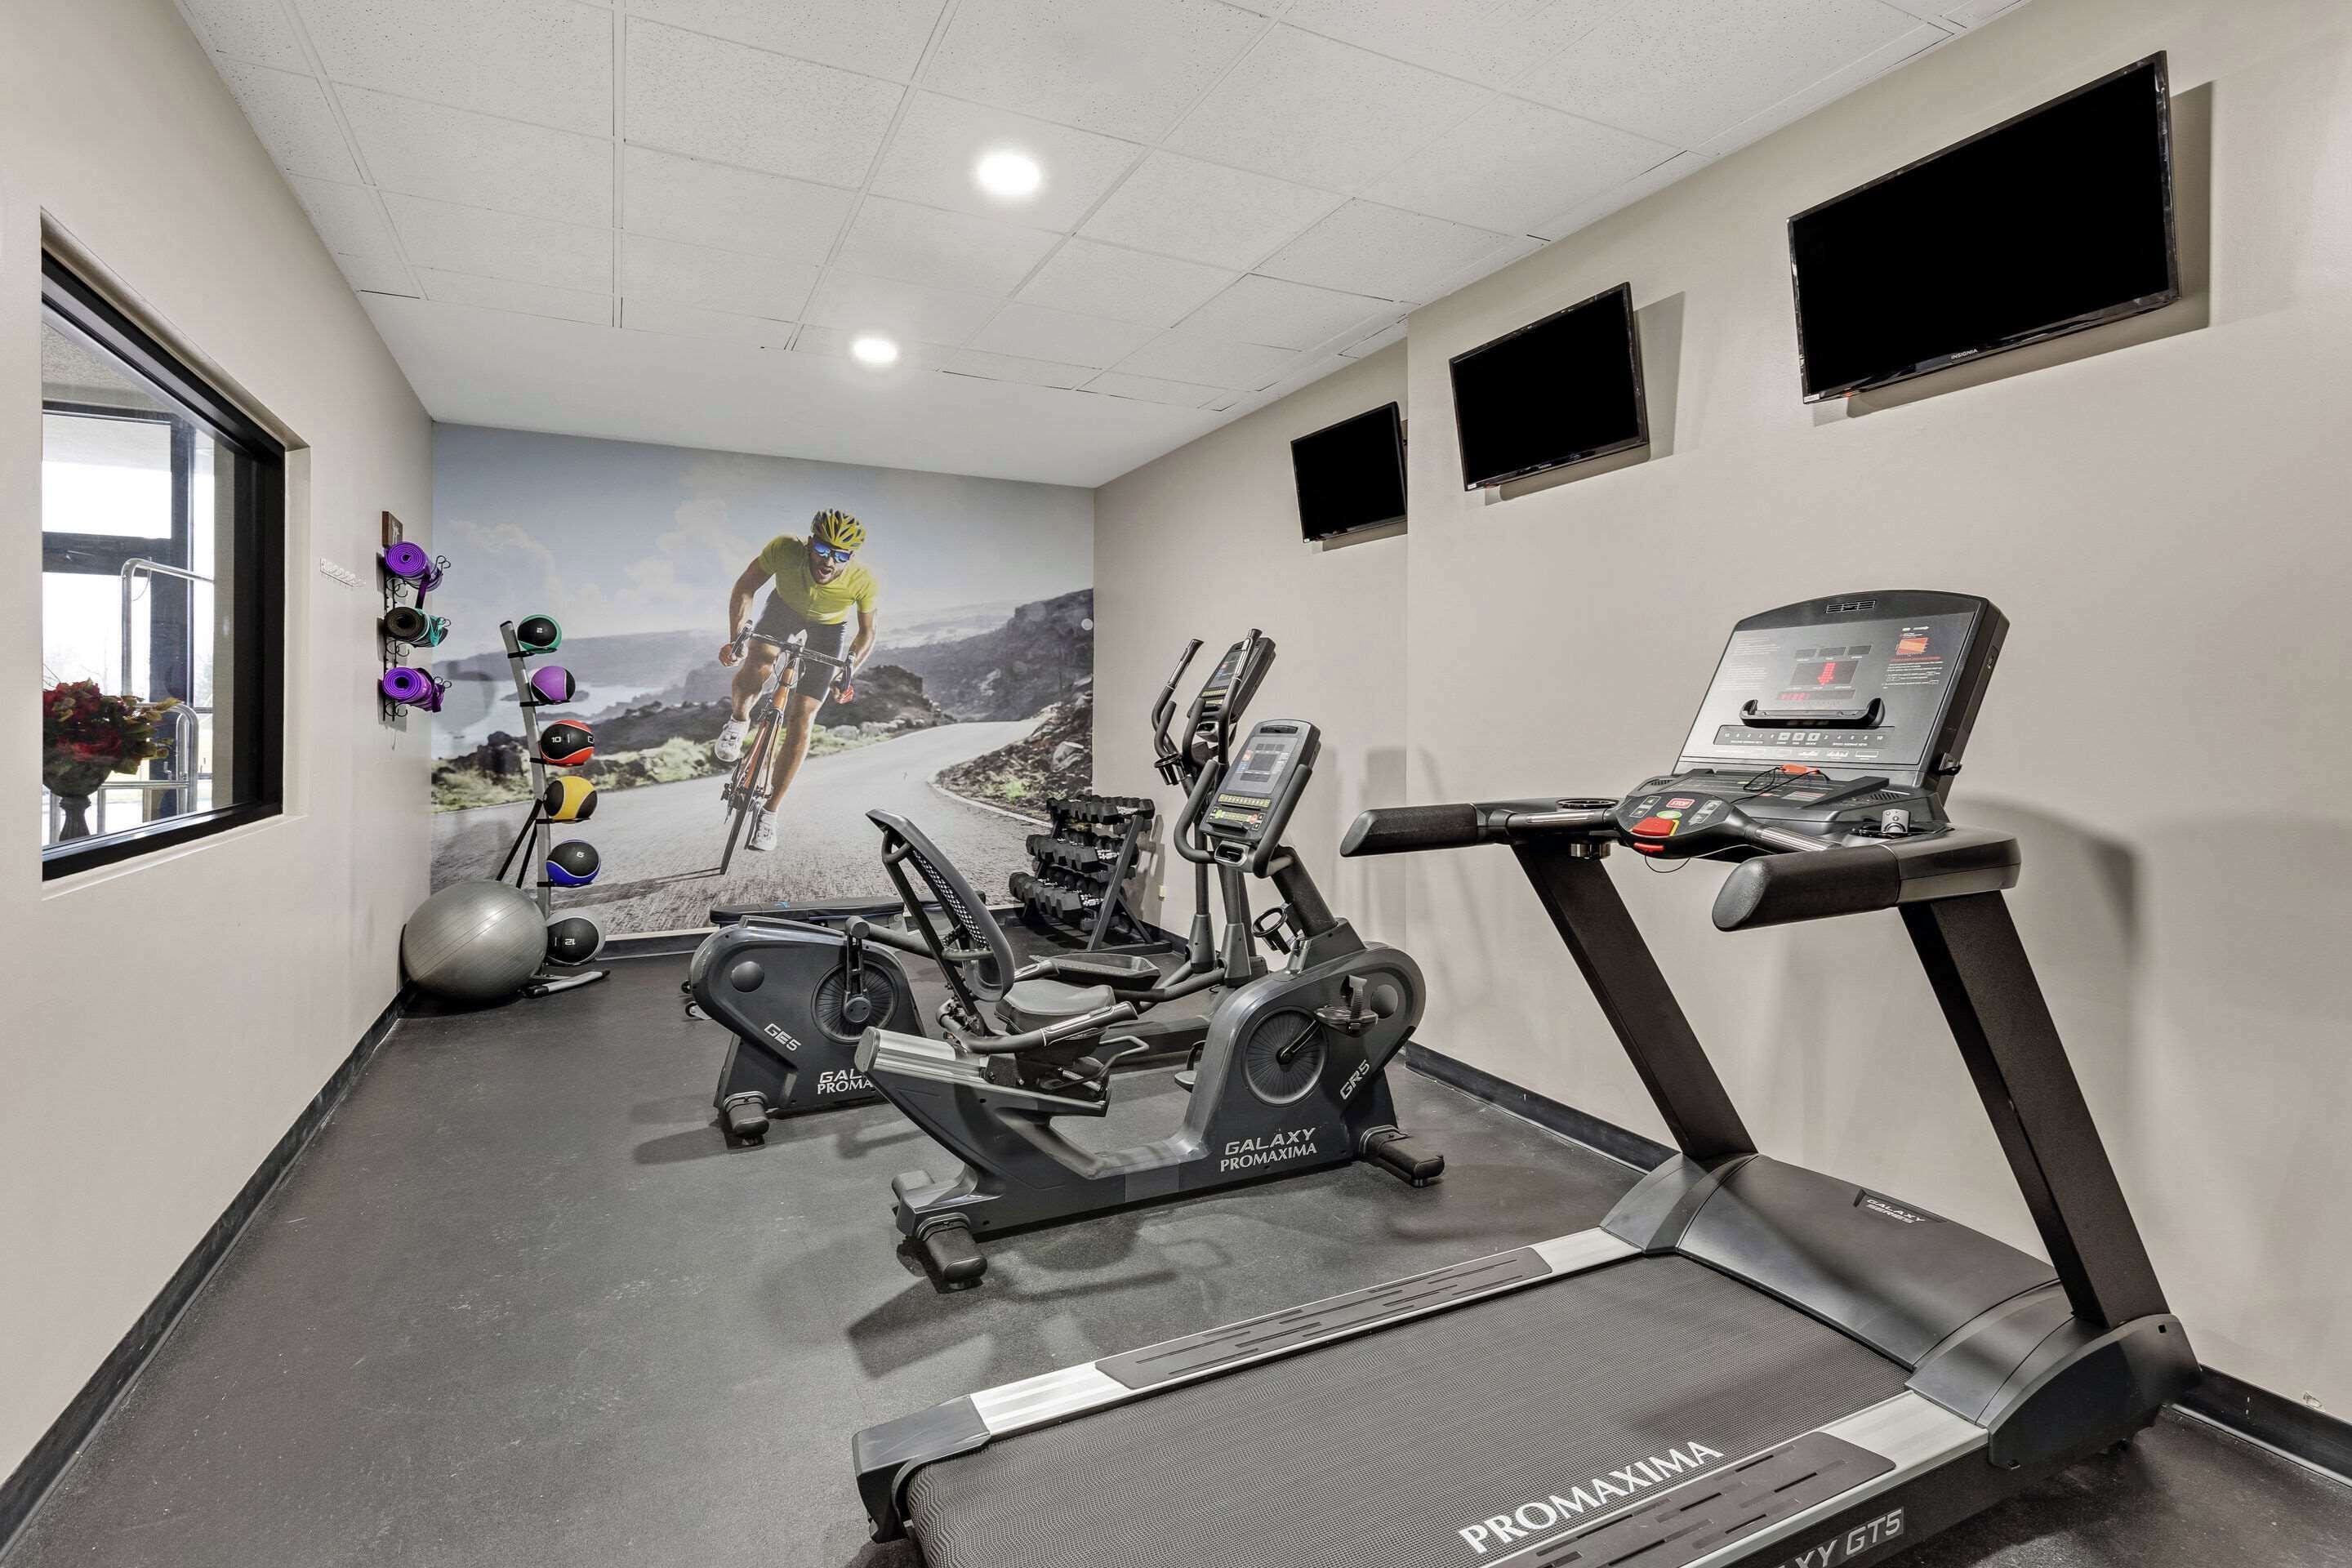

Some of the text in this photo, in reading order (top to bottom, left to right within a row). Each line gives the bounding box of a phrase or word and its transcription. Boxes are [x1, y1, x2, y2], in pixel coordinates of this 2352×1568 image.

[1950, 349, 1978, 359] INSIGNIA
[764, 1022, 802, 1052] GE5
[817, 1079, 875, 1095] PROMA
[819, 1068, 862, 1084] GAL
[1339, 1058, 1370, 1100] GR5
[1224, 1127, 1316, 1156] GALAXY
[1219, 1143, 1318, 1173] PROMAXIMA
[1866, 1199, 1926, 1221] GALAXY
[1458, 1441, 1725, 1553] PROMAXIMA
[1846, 1508, 1902, 1555] GT5
